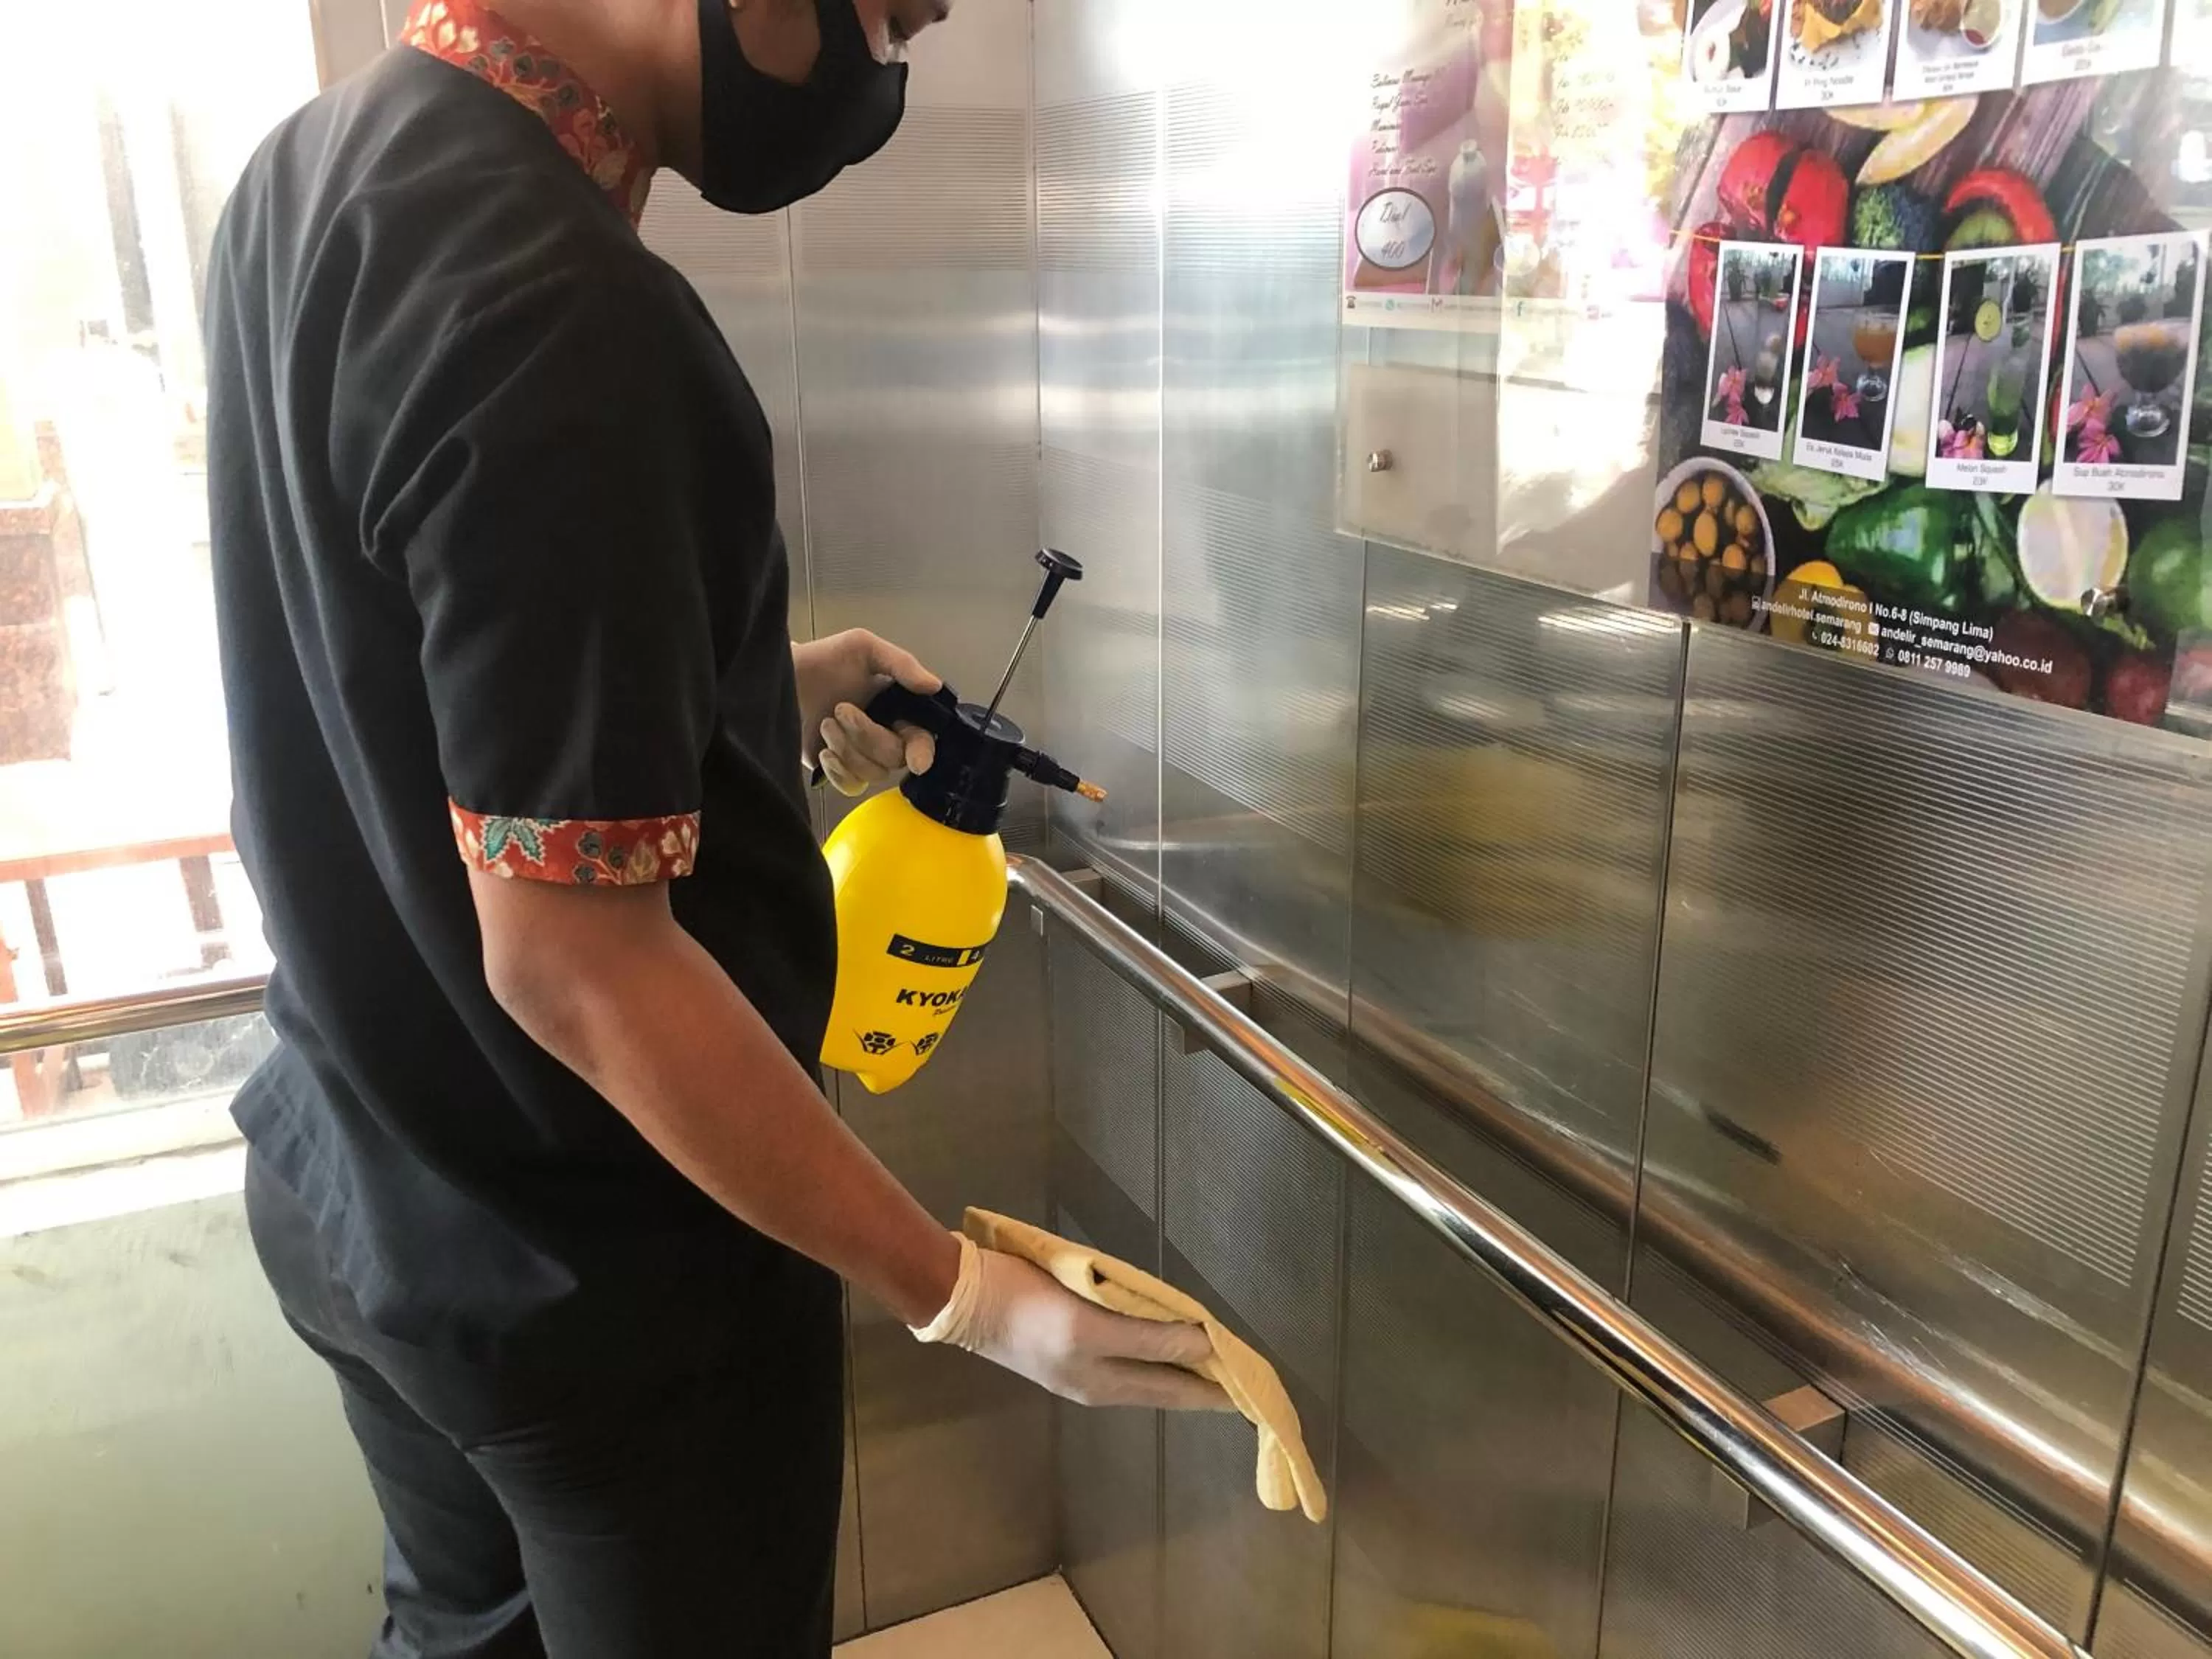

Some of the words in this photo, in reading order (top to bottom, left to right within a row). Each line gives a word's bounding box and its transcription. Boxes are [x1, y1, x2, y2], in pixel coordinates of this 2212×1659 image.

[1812, 591, 1868, 613] Atmodirono
[1875, 603, 1907, 622] No.6-8
[1909, 611, 1960, 636] (Simpang
[1962, 622, 1994, 642] Lima)
[1881, 627, 2053, 674] andelir_semarang@yahoo.co.id
[1897, 649, 1921, 667] 0811
[1924, 655, 1943, 670] 257
[900, 944, 915, 956] 2
